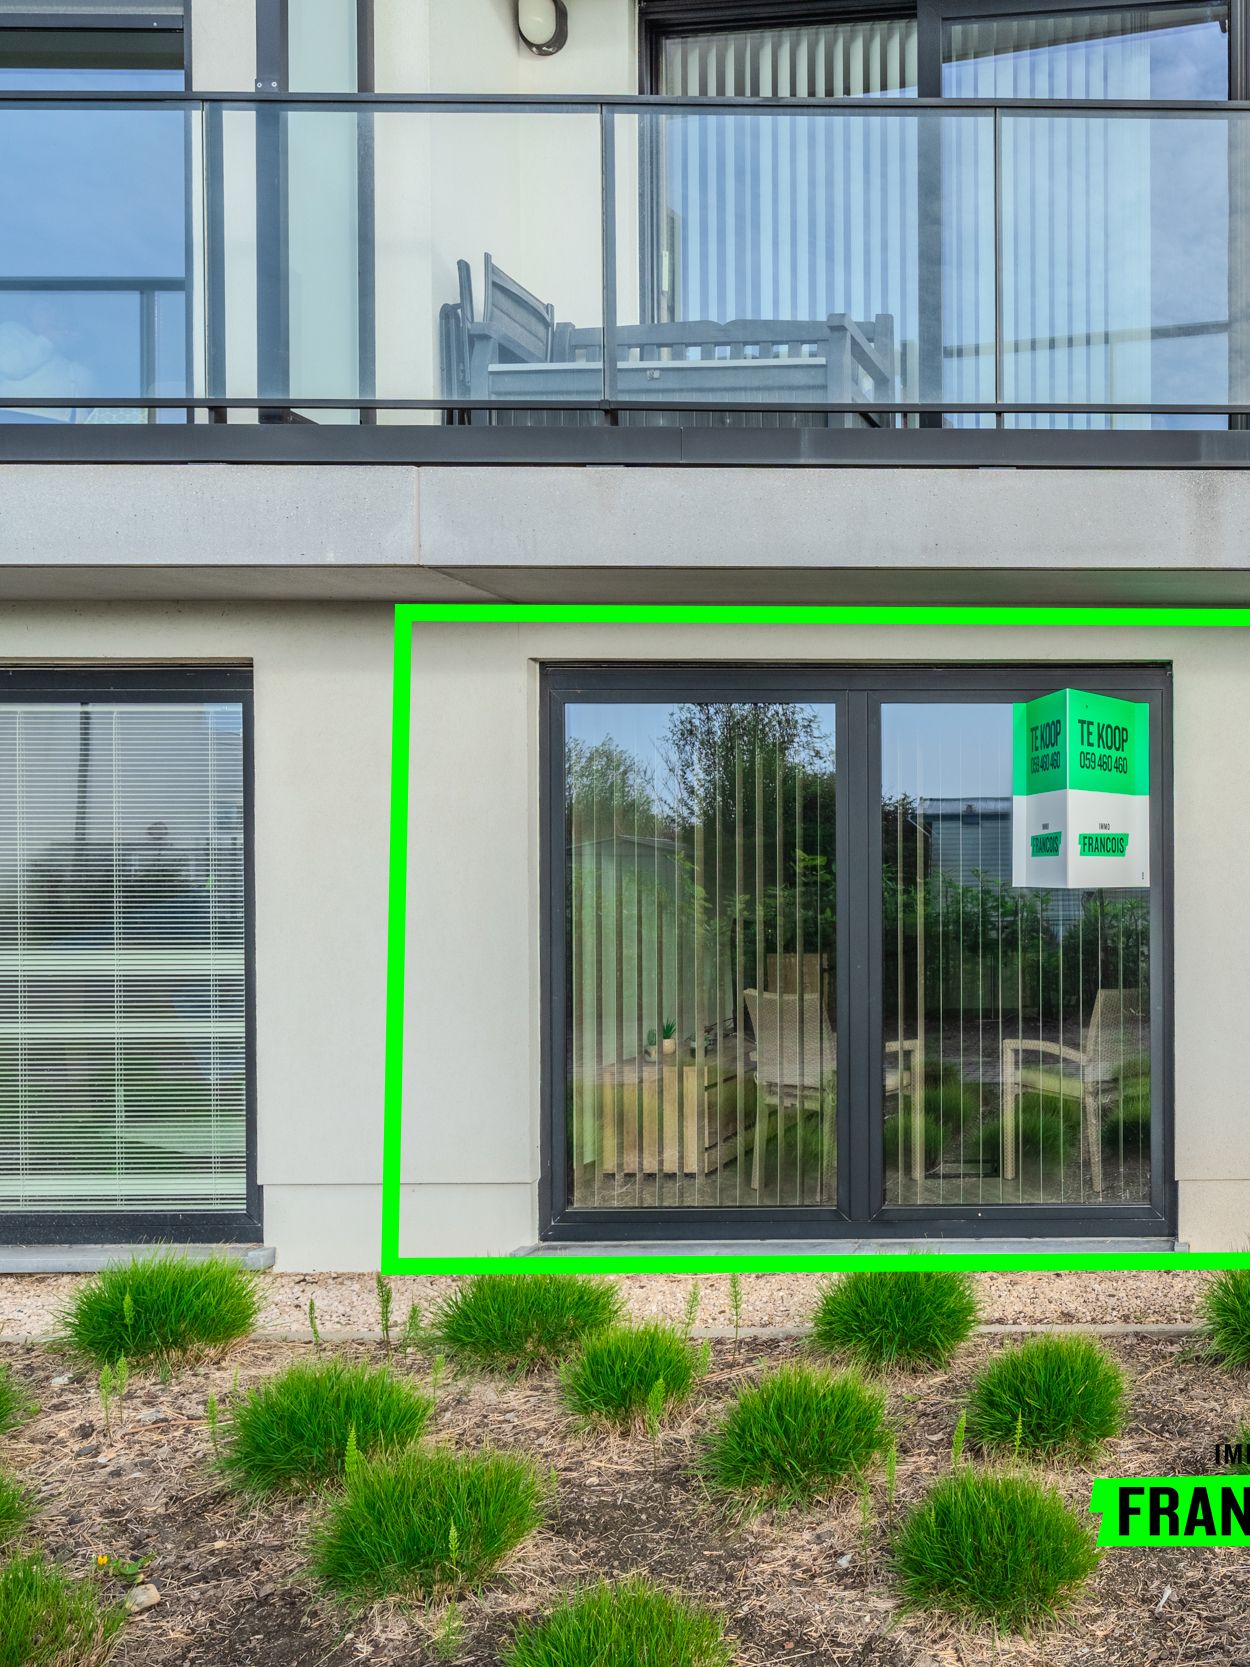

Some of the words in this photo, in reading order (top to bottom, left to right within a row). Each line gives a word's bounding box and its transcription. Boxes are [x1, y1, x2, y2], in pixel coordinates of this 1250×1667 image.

[1030, 725, 1039, 753] TE
[1040, 719, 1062, 750] KOOP
[1078, 719, 1094, 747] TE
[1098, 723, 1129, 752] KOOP
[1079, 753, 1096, 770] 059
[1097, 755, 1112, 772] 460
[1113, 757, 1128, 774] 460
[1032, 835, 1060, 854] FRANCOIS
[1082, 835, 1125, 854] FRANCOIS
